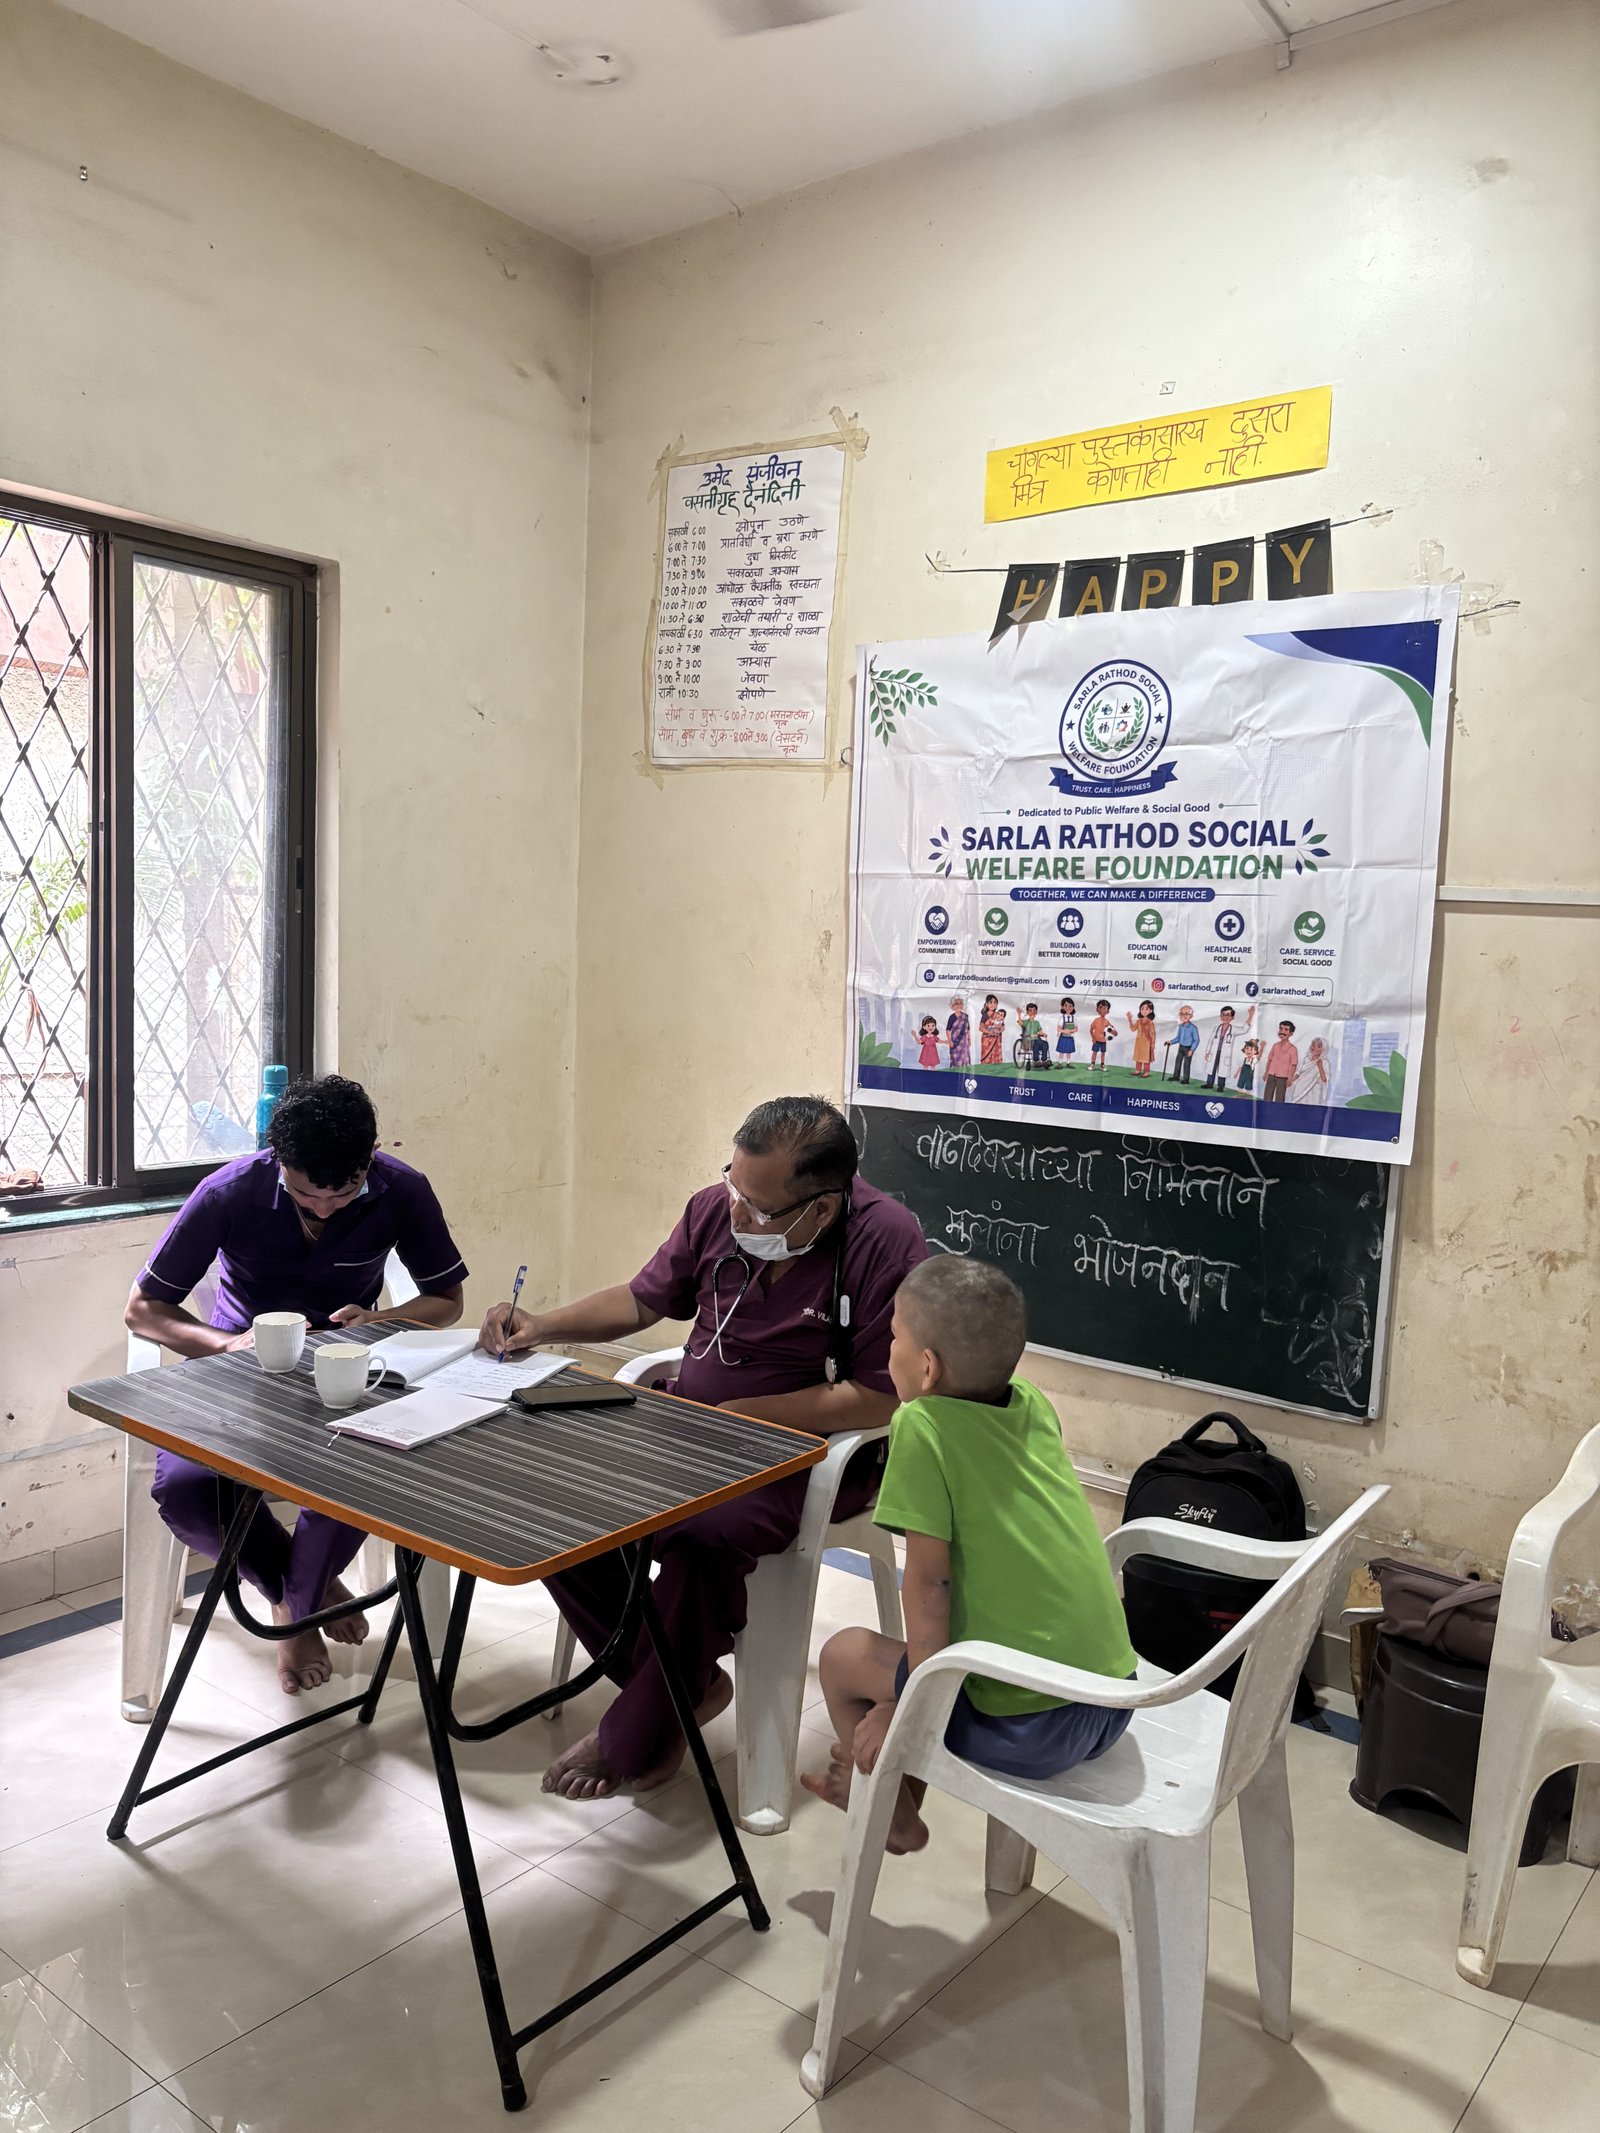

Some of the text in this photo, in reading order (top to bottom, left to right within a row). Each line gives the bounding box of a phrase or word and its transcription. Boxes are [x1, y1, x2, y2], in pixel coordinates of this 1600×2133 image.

[1230, 402, 1296, 443] दुसरा
[697, 454, 803, 491] उमेद संजीवन
[1010, 474, 1049, 507] मित्र
[1087, 448, 1177, 495] कोणताही
[779, 514, 809, 526] उठणे
[1014, 538, 1315, 617] HAPPY
[741, 671, 769, 684] जेवण
[658, 685, 676, 699] रात्री
[1073, 668, 1163, 711] SARLA RATHOD SOCIAL
[1068, 736, 1158, 775] WELFARE FOUNDATION
[1114, 782, 1151, 793] HAPPINESS
[1018, 802, 1210, 817] Dedicated to Public Welfare & Social Good
[961, 819, 1296, 852] SARLA RATHOD SOCIAL
[966, 854, 1283, 881] WELFARE FOUNDATION
[1018, 889, 1207, 900] TOGETHER, WE CAN MAKE A DIFFERENCE
[917, 938, 957, 946] EMPOWERING
[978, 940, 1015, 948] SUPPORTING
[1050, 941, 1080, 949] BUILDING
[1127, 943, 1168, 952] EDUCATION
[918, 947, 955, 955] COMMUNITIES
[1062, 951, 1099, 959] TOMORROW
[1204, 946, 1252, 954] HEALTHCARE
[1279, 948, 1301, 956] CARE.
[1228, 956, 1242, 964] ALL
[1282, 958, 1333, 967] SOCIAL GOOD
[1168, 983, 1229, 993] sarlarathod_swf
[1262, 987, 1325, 997] sarlarathod_swf
[1009, 1086, 1036, 1097] TRUST
[1068, 1091, 1093, 1103] CARE
[1127, 1097, 1181, 1111] HAPPINESS
